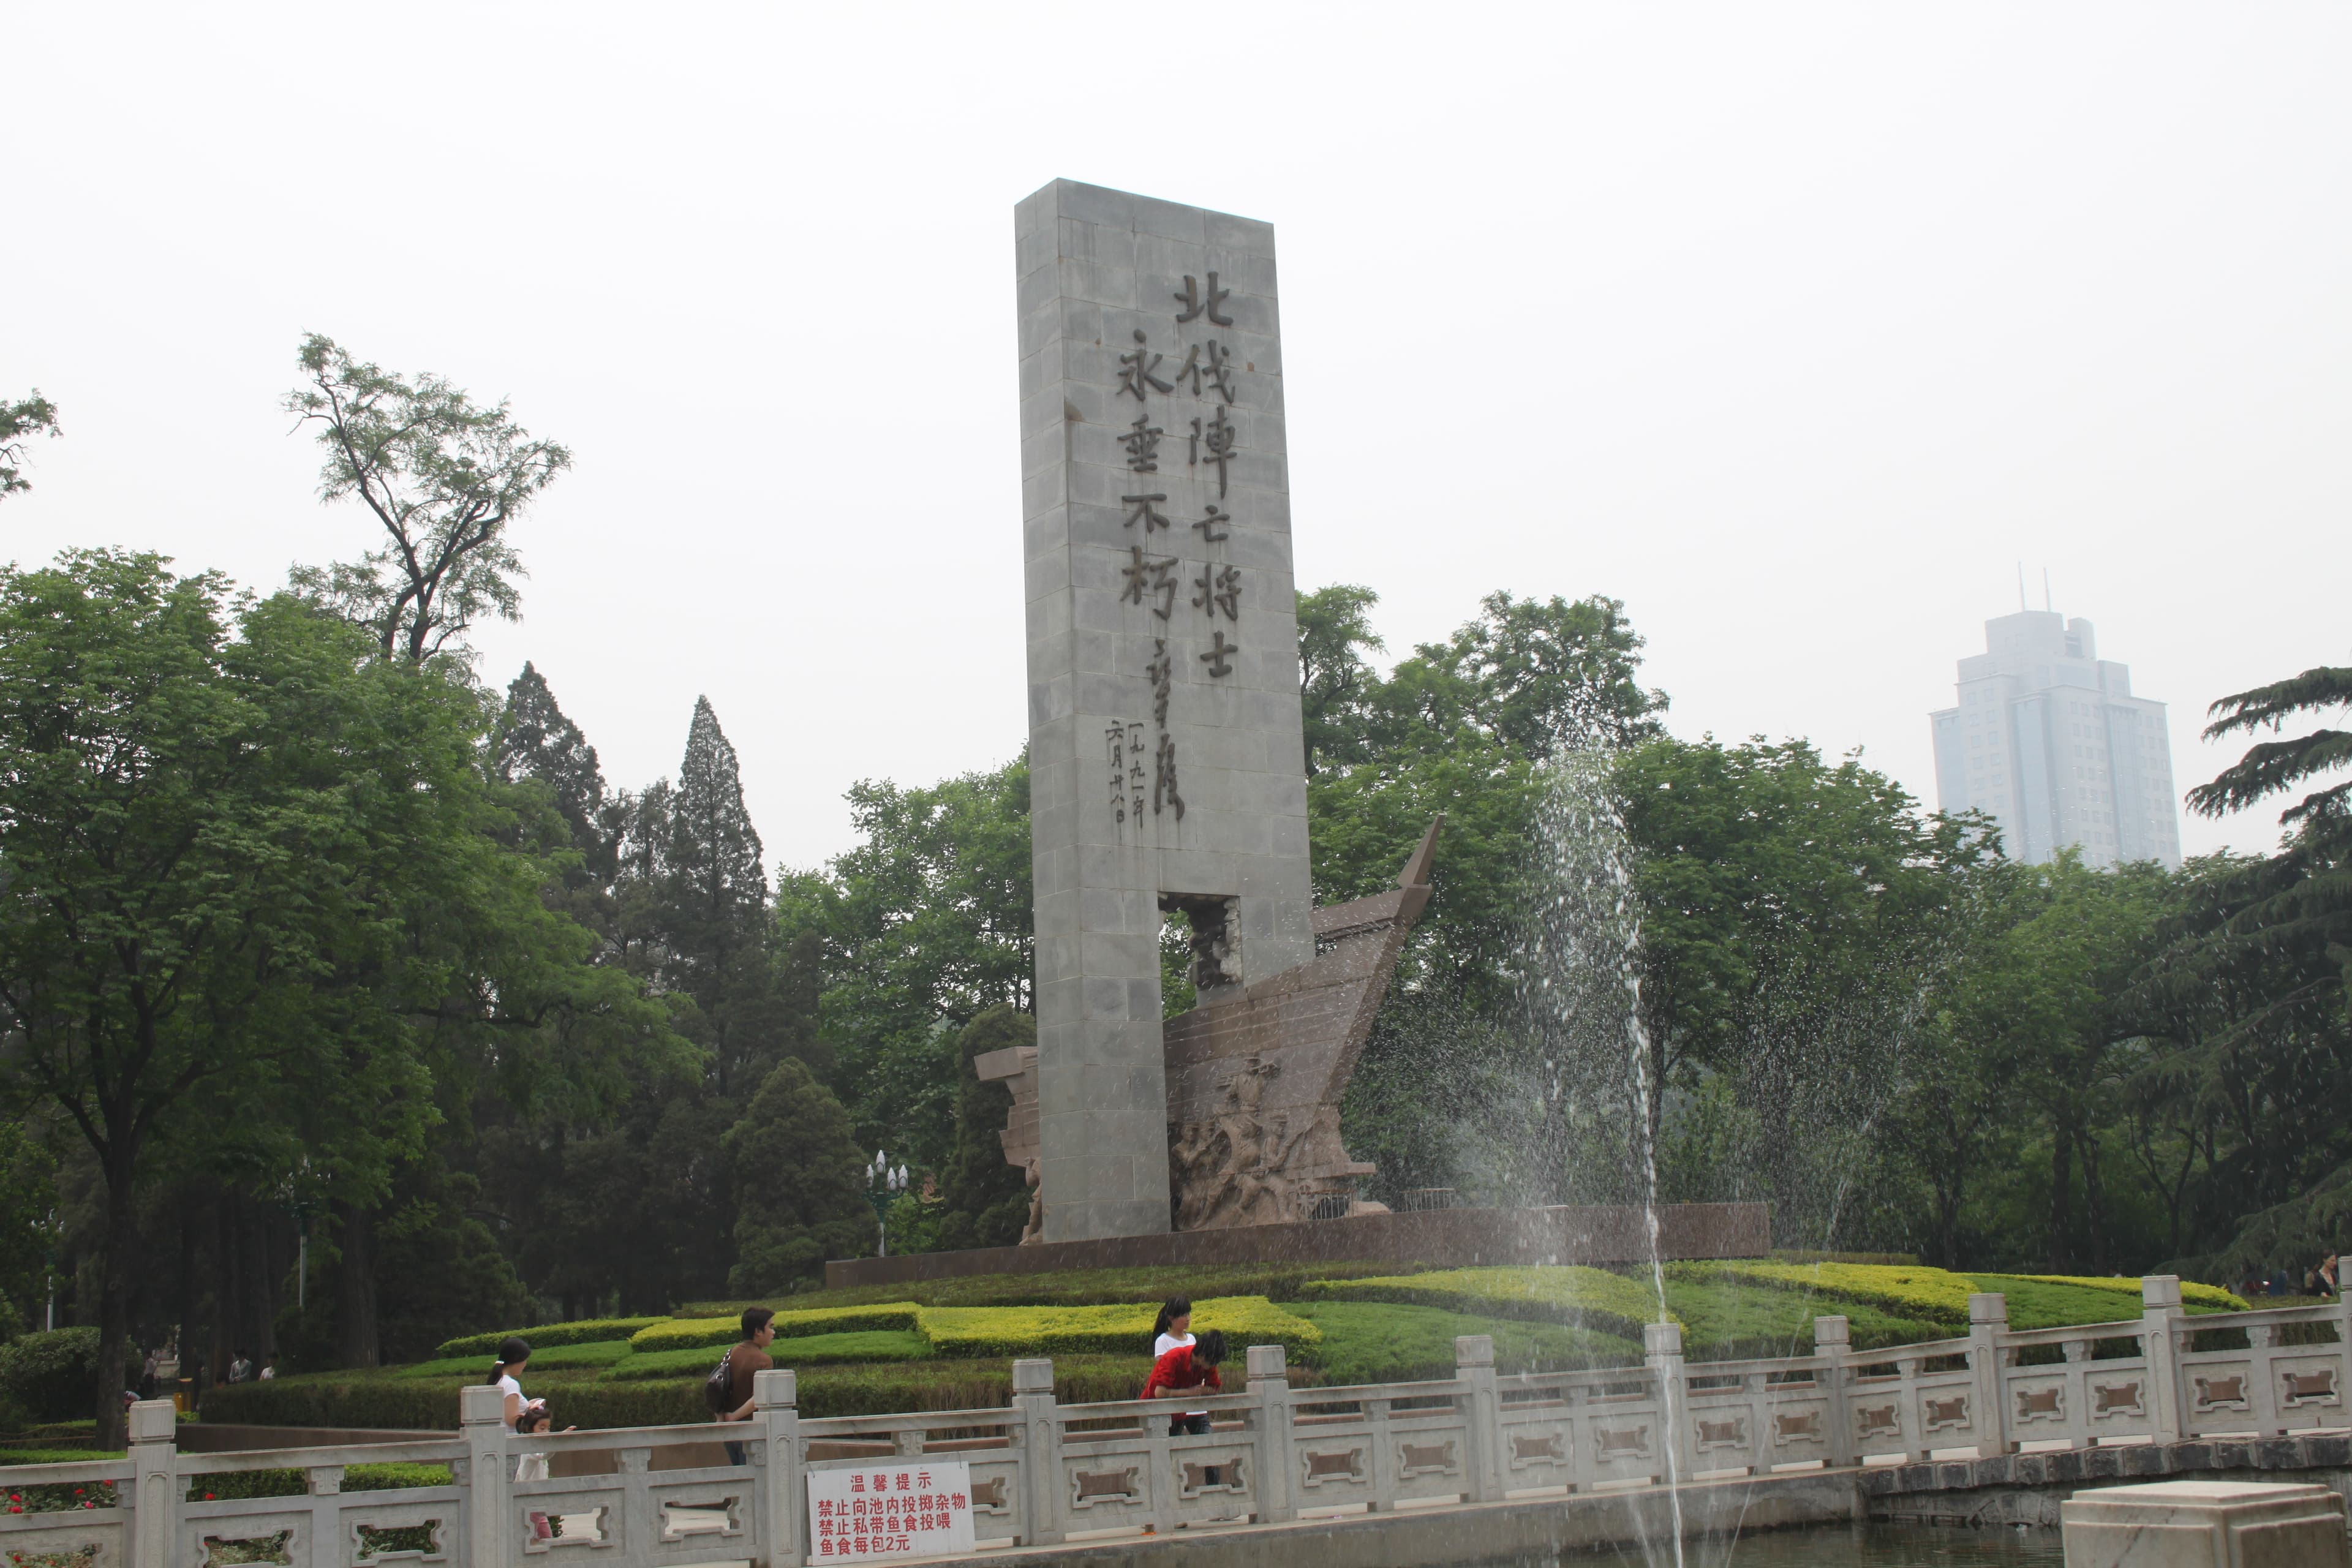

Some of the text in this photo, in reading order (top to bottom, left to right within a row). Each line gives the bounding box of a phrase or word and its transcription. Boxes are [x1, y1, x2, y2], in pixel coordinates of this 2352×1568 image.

[1116, 328, 1179, 622] 永垂不朽
[1128, 723, 1145, 829] 一九九一年
[850, 1472, 932, 1493] 温馨提示
[818, 1493, 966, 1518] 禁止向池内投掷杂物
[818, 1512, 951, 1537] 禁止私带鱼食投喂
[820, 1534, 910, 1556] 鱼食每包2元
